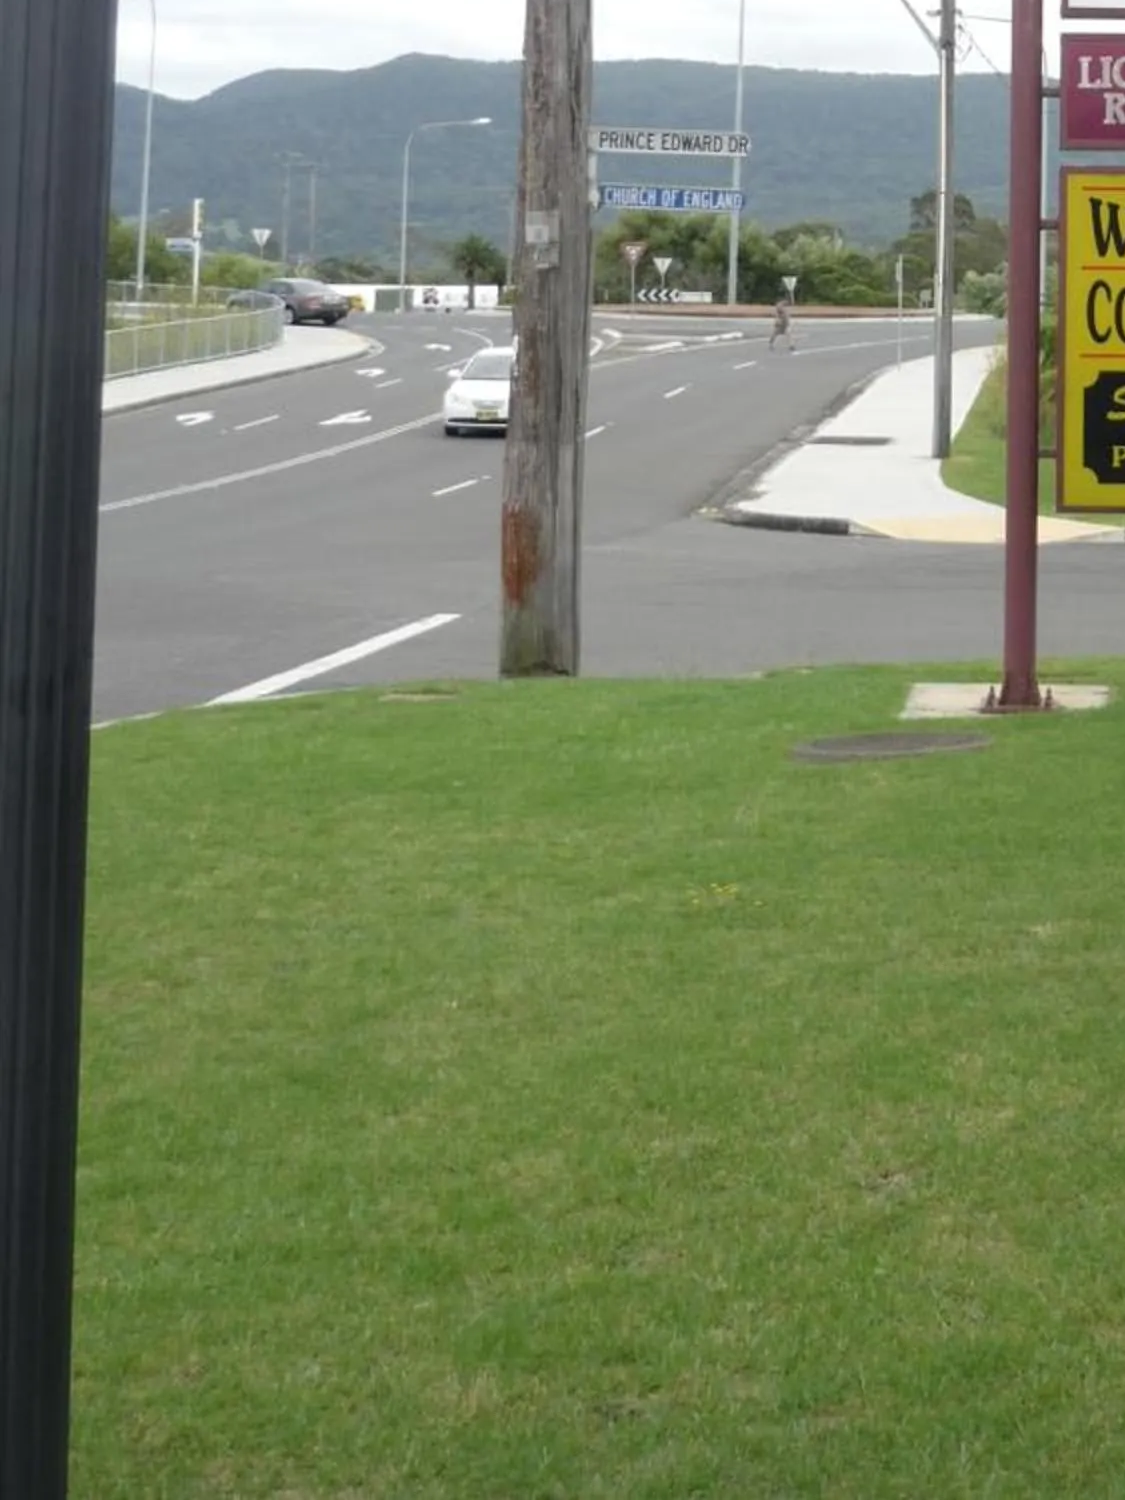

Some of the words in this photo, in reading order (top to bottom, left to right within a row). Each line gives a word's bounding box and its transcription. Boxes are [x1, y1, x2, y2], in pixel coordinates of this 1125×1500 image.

[599, 131, 656, 150] PRINCE
[661, 134, 723, 153] EDWARD
[728, 135, 749, 153] DR
[604, 187, 657, 208] CHURCH
[661, 190, 677, 208] OF
[683, 190, 743, 211] ENGLAND
